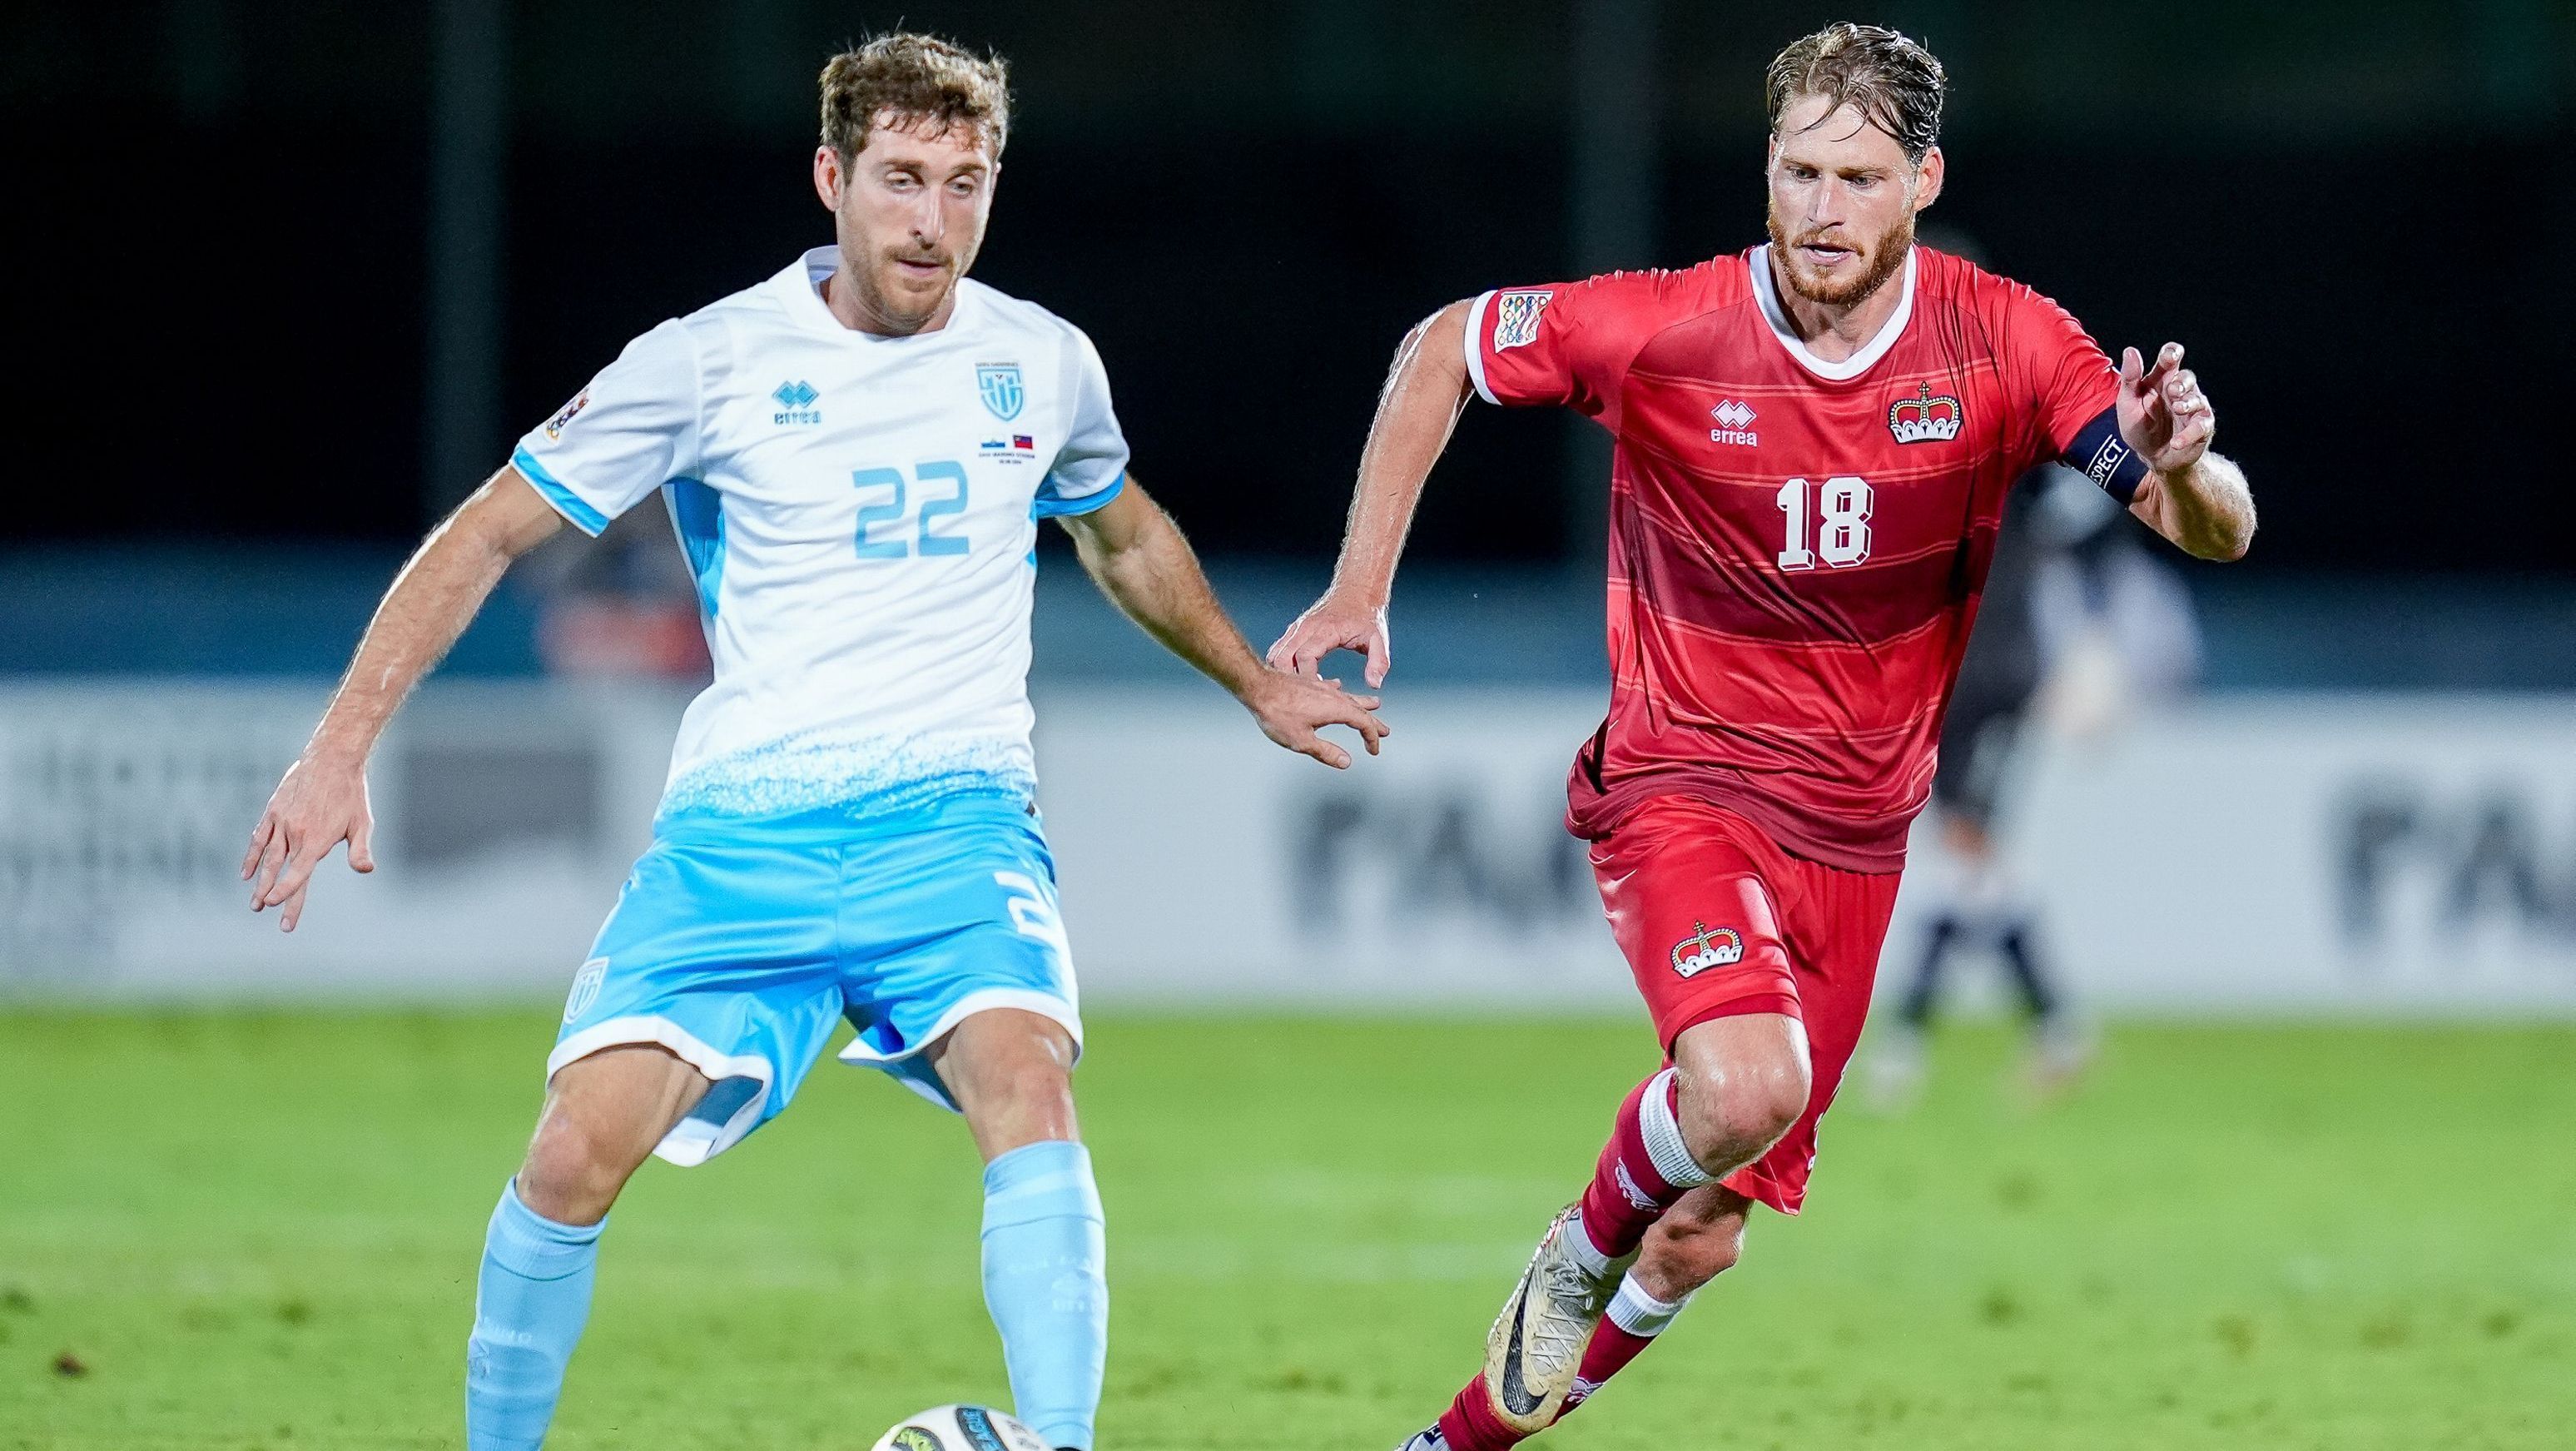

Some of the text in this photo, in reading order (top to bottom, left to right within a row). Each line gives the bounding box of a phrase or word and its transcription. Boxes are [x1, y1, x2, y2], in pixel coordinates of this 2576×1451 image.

[1710, 429, 1757, 446] errea
[2089, 438, 2123, 486] SPECT
[851, 460, 970, 559] 22
[1777, 476, 1874, 572] 18
